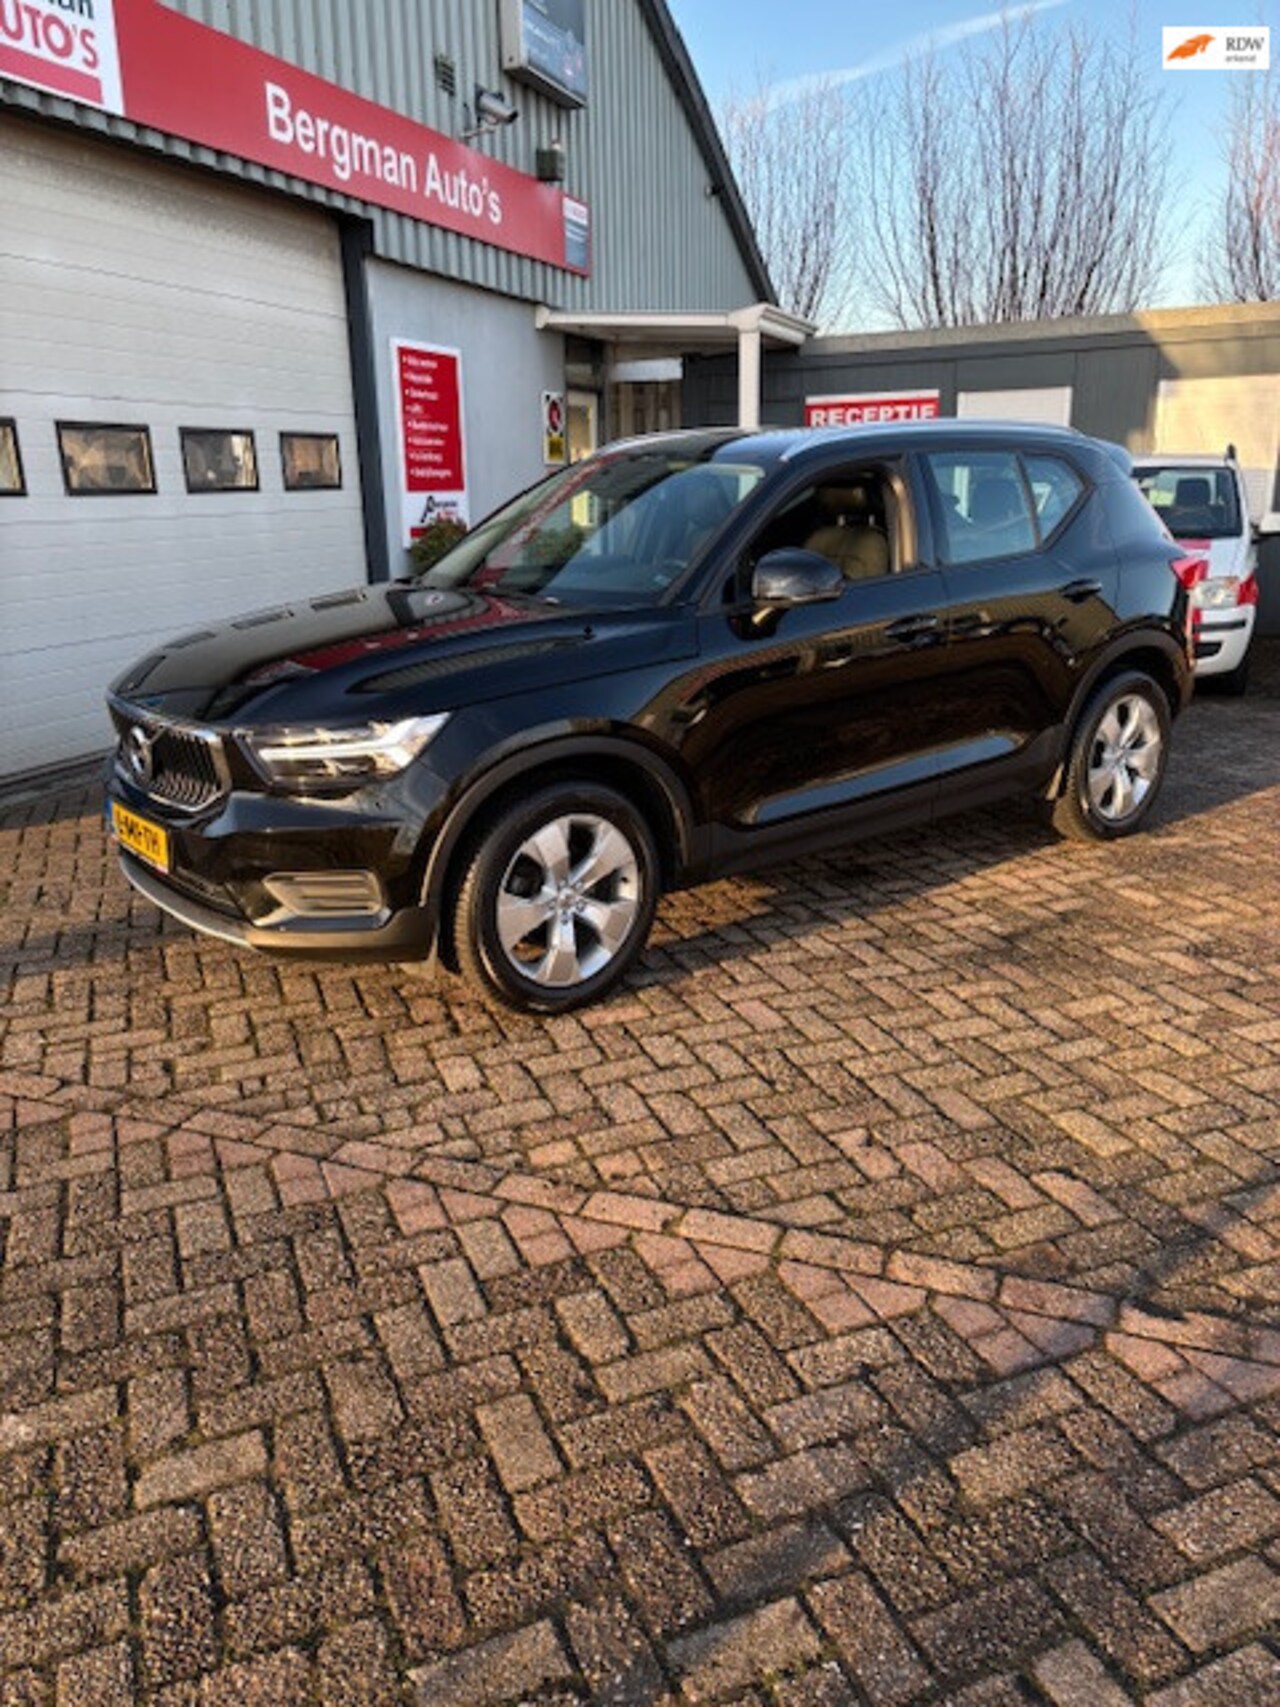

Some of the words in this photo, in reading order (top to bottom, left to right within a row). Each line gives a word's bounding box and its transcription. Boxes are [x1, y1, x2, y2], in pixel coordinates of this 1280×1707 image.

[0, 0, 98, 69] UTO'S
[265, 81, 417, 193] Bergman
[424, 153, 502, 224] Auto's
[810, 403, 935, 427] RECEPTIE
